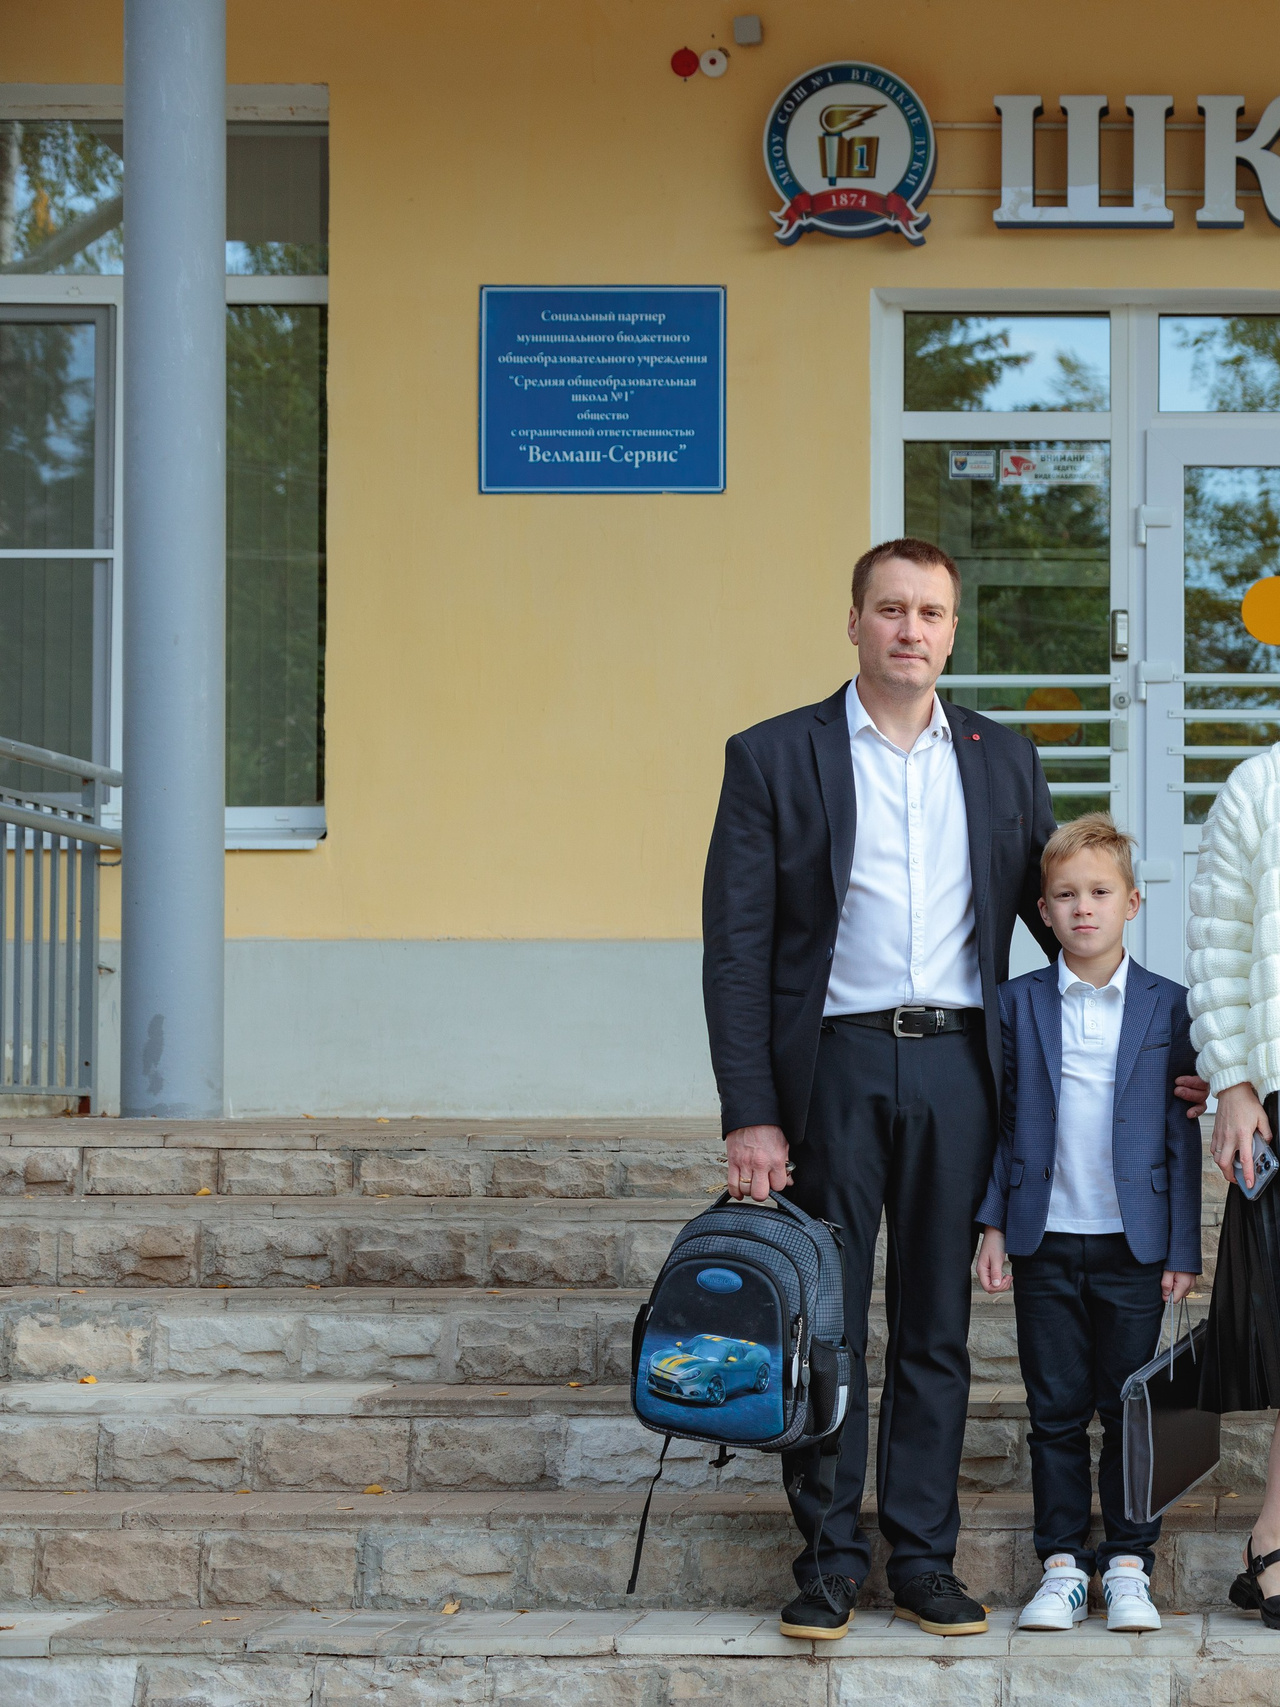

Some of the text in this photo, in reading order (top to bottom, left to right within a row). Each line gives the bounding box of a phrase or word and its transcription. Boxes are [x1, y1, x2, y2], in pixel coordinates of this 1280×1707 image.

[850, 68, 922, 127] ВЕЛИКИЕ
[777, 87, 807, 125] СОШ
[772, 133, 793, 186] МБОУ
[855, 144, 869, 171] 1
[906, 136, 926, 187] ЛУКИ
[831, 193, 868, 207] 1874
[541, 309, 666, 325] Социальный партнер
[516, 330, 690, 346] муниципального бюджетного
[498, 351, 708, 367] общеобразовательного учреждения
[508, 374, 697, 390] "Средняя общеобразовательная
[571, 391, 608, 402] школа
[577, 409, 629, 421] общество
[511, 427, 695, 441] с ограниченной ответственностью
